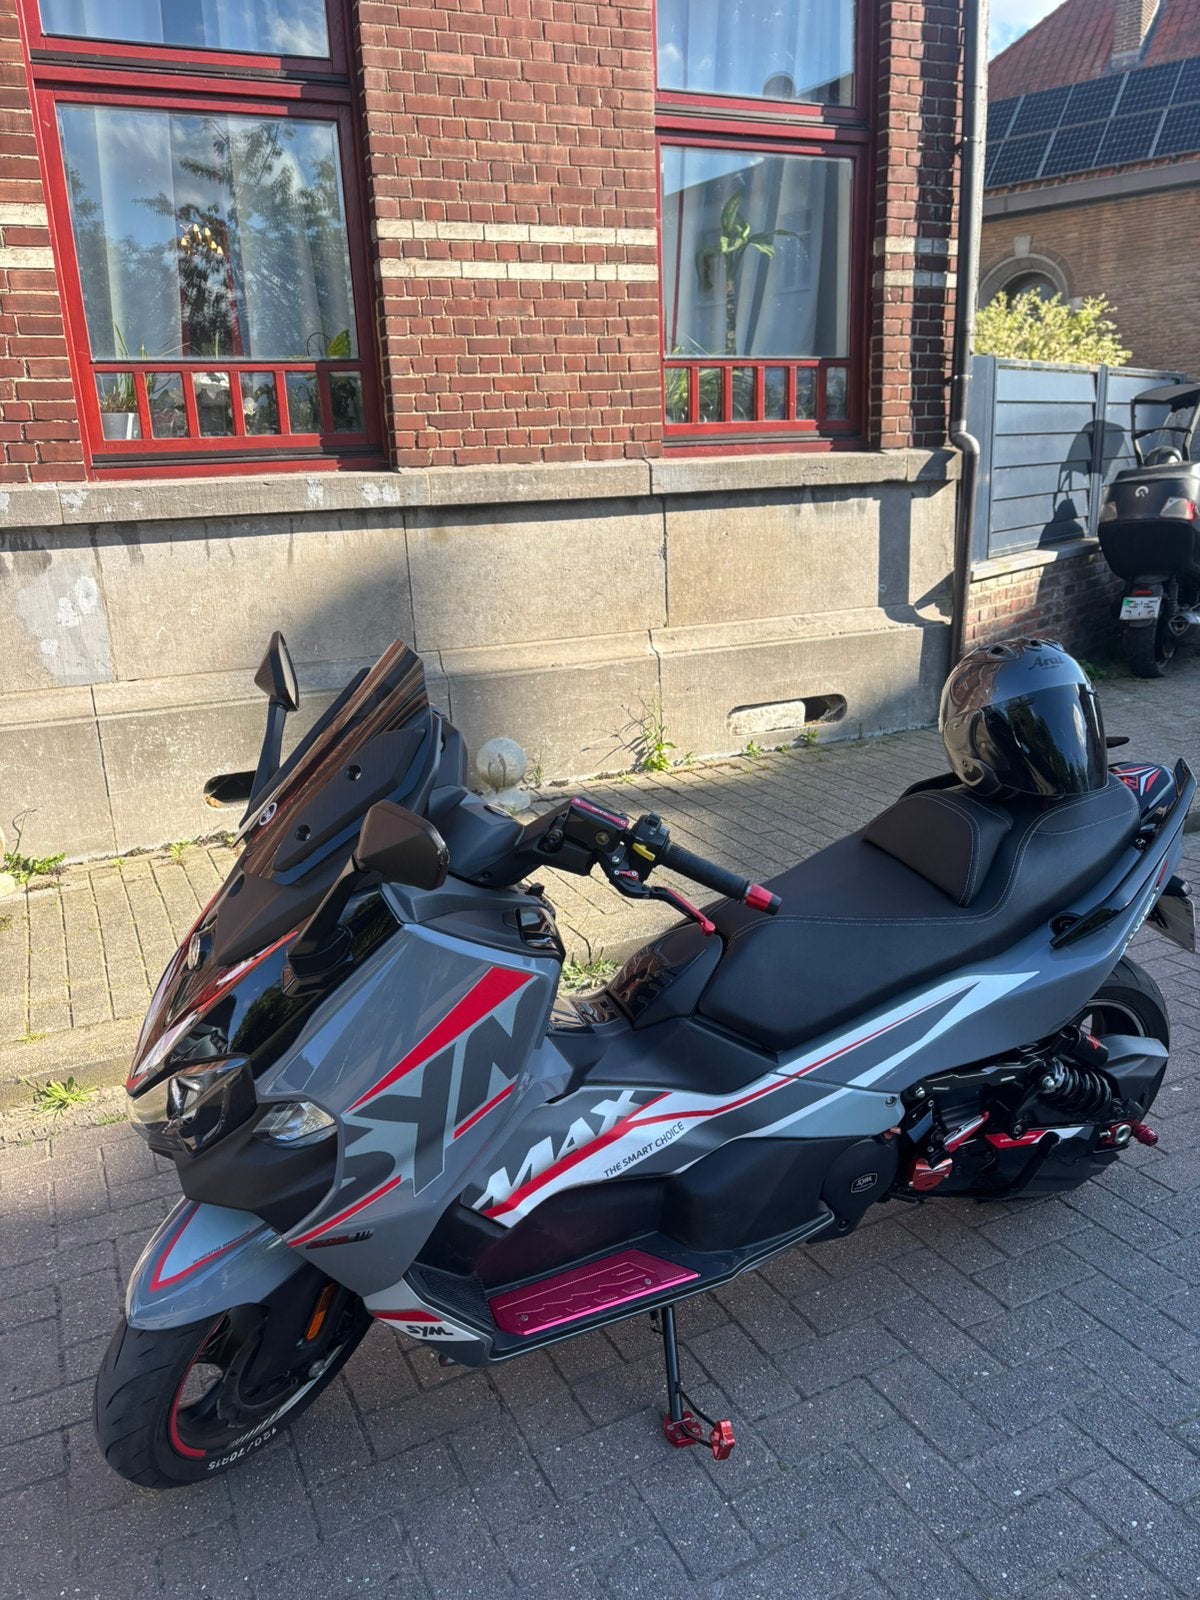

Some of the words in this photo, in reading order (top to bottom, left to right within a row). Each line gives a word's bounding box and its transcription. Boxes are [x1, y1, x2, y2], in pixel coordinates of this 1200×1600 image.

[1028, 656, 1065, 671] Arai
[471, 1089, 641, 1211] MAX
[603, 1162, 623, 1178] THE
[622, 1142, 654, 1168] SMART
[654, 1121, 685, 1148] CHOICE
[406, 1325, 455, 1337] SYM
